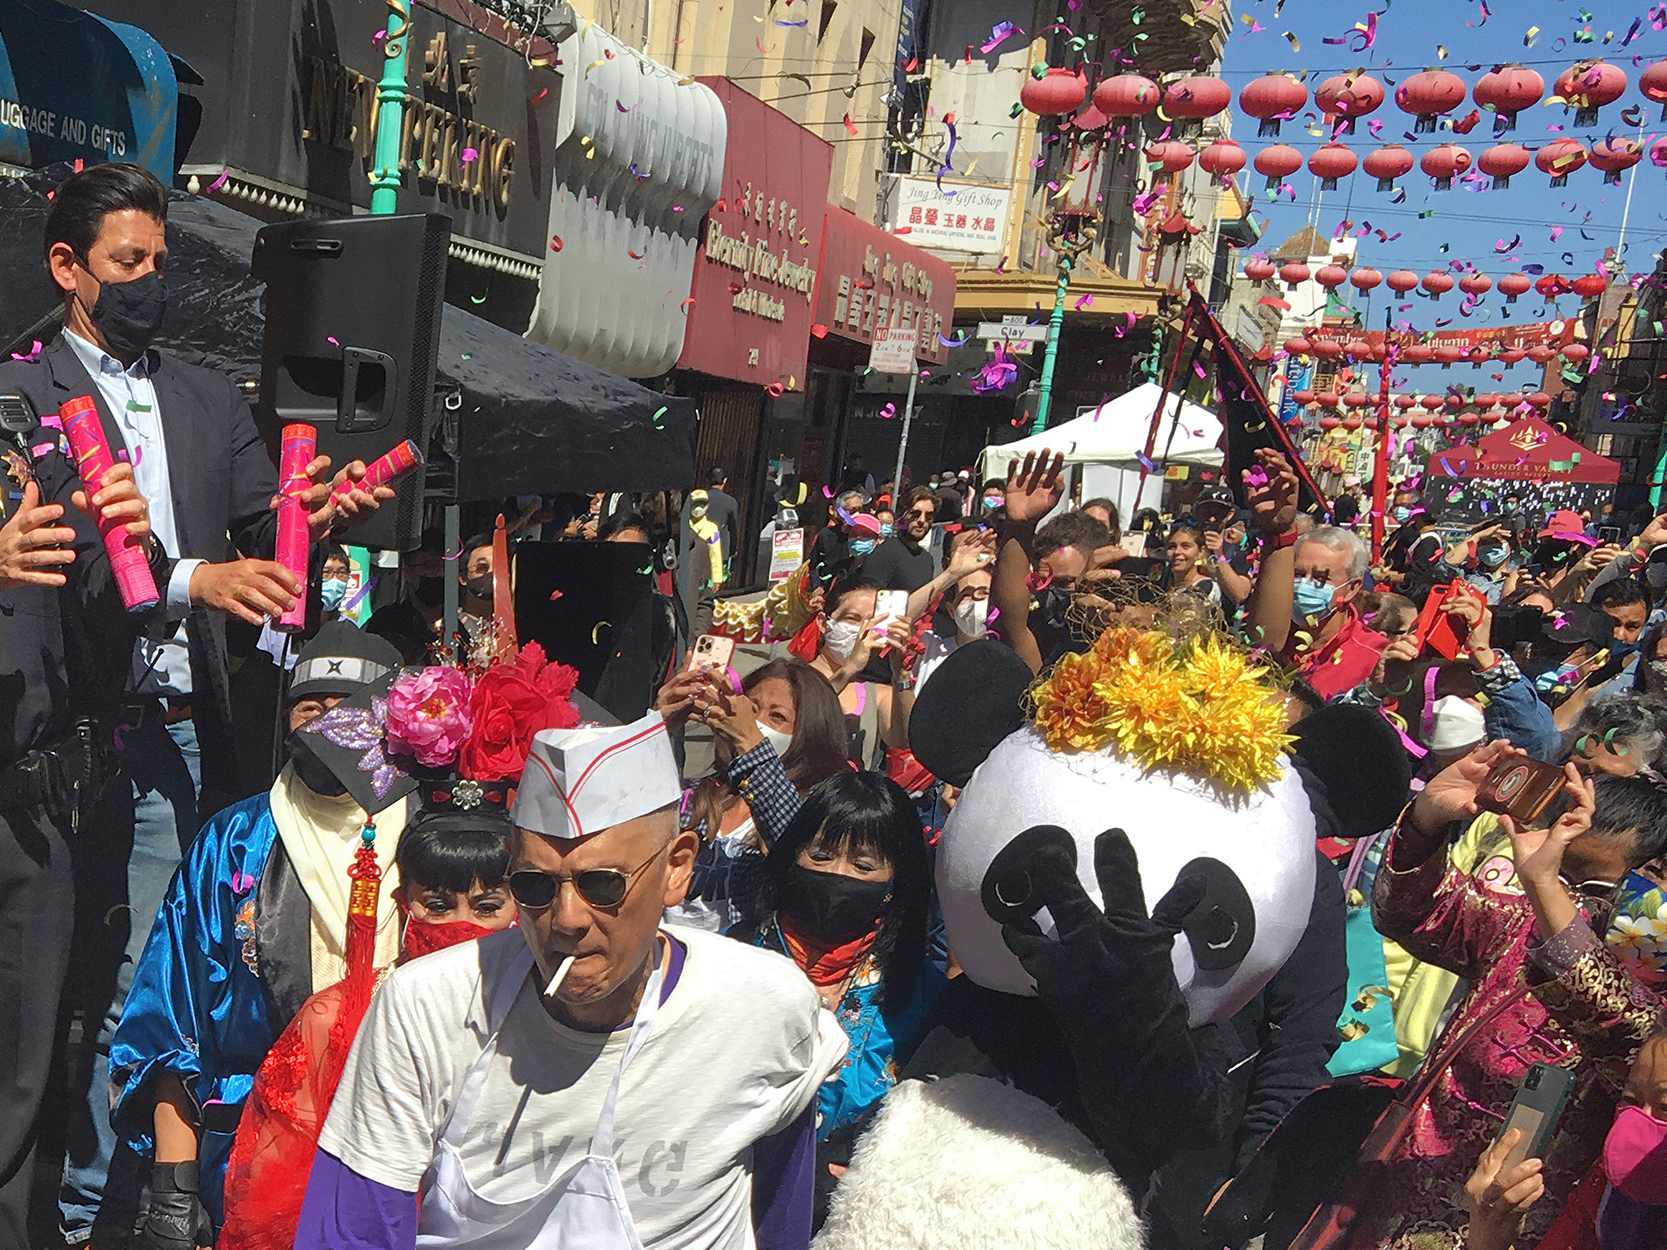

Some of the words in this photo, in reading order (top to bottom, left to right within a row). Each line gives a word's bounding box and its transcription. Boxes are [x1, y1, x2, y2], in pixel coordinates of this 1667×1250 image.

[61, 116, 87, 145] AND
[91, 124, 126, 156] GIFTS
[906, 187, 929, 202] Jing
[956, 191, 976, 207] Gift
[977, 193, 1003, 210] Shop
[971, 216, 996, 232] 水晶
[752, 238, 779, 282] Fine
[777, 248, 817, 303] Jewelry
[875, 328, 888, 341] NO
[888, 331, 916, 342] PARKING
[1000, 326, 1025, 339] Clay
